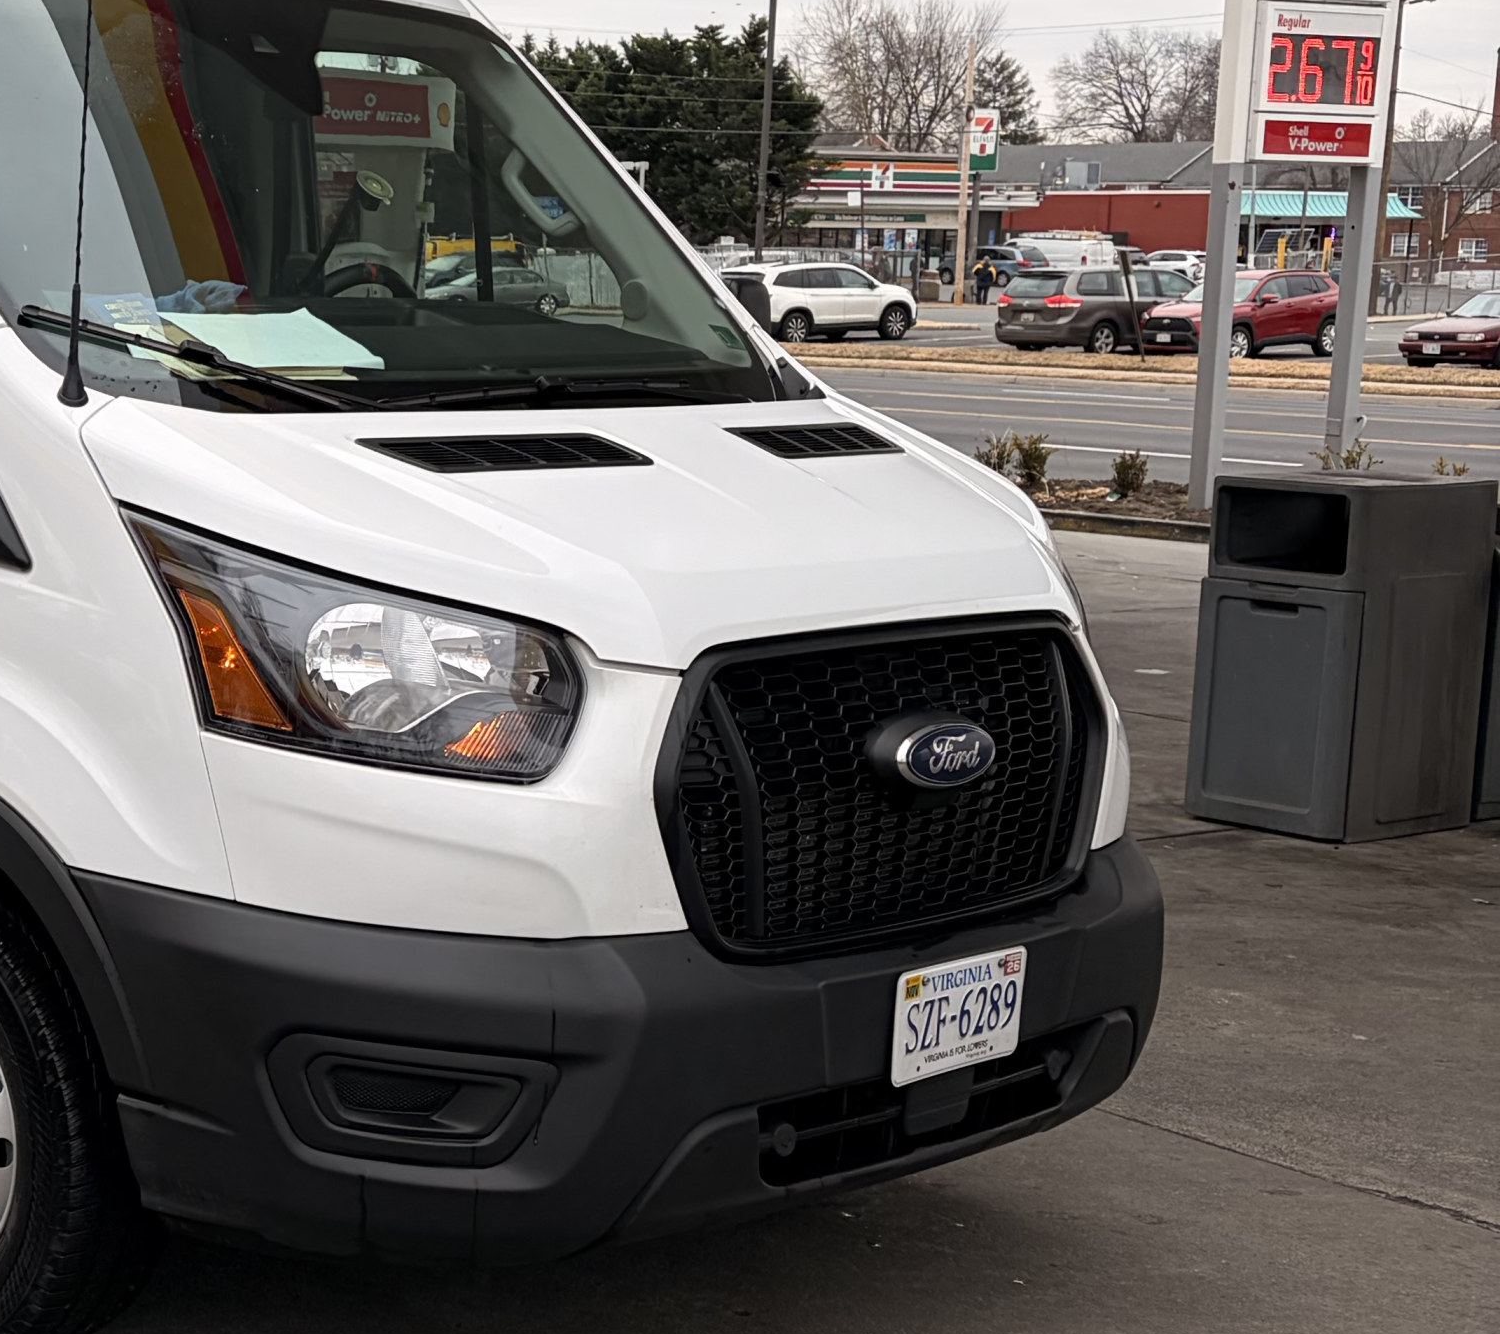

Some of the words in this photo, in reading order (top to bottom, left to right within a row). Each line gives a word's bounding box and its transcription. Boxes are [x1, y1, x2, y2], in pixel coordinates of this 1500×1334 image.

[1277, 14, 1311, 31] Regular
[1266, 36, 1357, 104] 2.67
[323, 104, 371, 121] Power
[1288, 125, 1309, 138] Shell
[1288, 136, 1339, 153] V-Power
[929, 734, 980, 774] Ford
[1006, 960, 1020, 974] 26
[932, 964, 992, 993] VIRGINIA
[905, 980, 1017, 1054] SZF-6289
